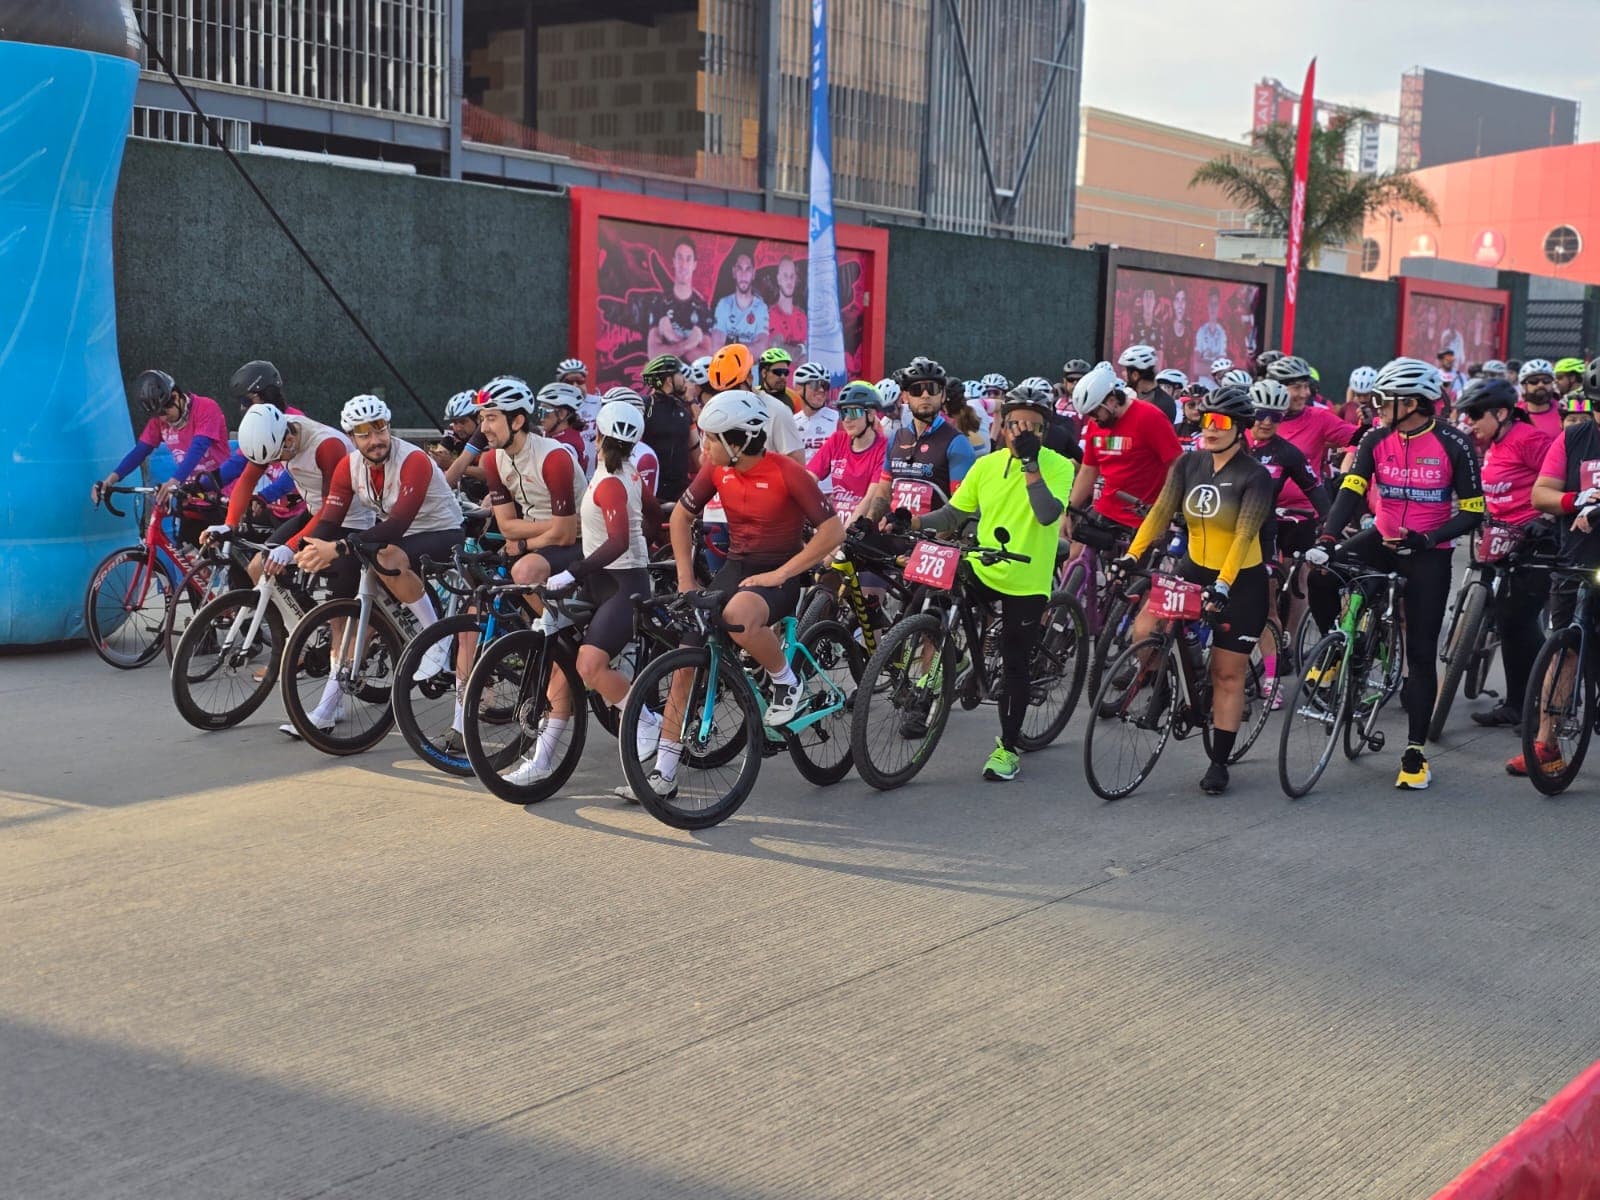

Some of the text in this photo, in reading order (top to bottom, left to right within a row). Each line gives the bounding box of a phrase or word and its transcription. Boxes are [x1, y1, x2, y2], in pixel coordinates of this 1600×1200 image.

[1378, 463, 1441, 479] Caporales
[897, 492, 922, 512] 244
[915, 554, 946, 578] 378
[1162, 589, 1186, 612] 311
